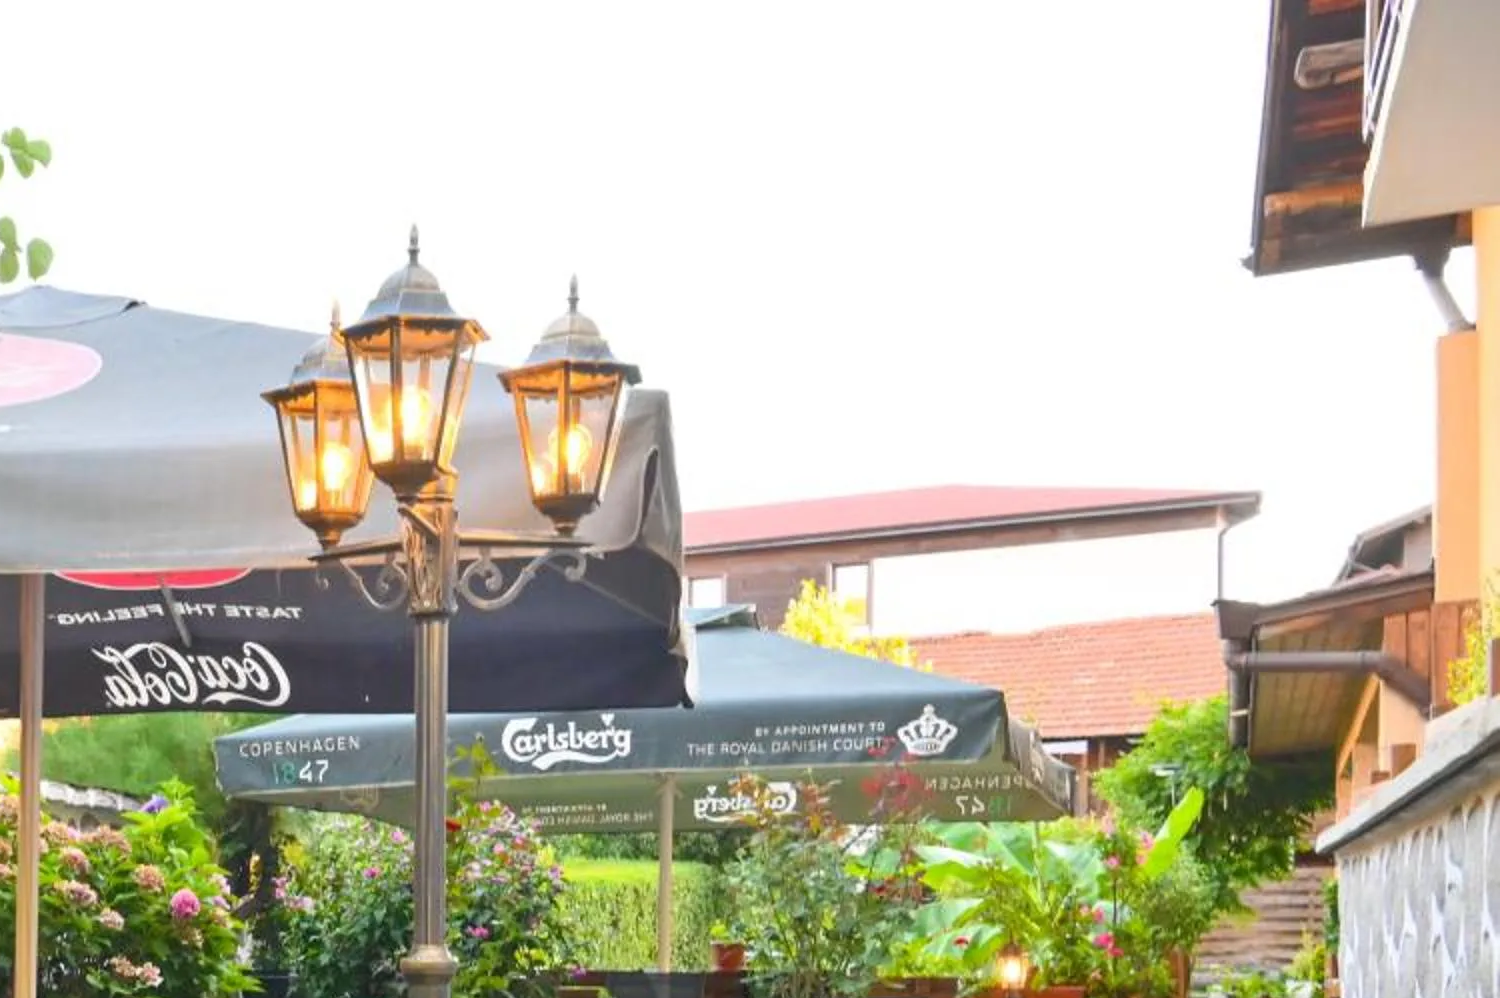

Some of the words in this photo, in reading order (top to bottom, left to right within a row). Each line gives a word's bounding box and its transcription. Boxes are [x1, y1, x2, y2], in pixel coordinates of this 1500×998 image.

[775, 722, 865, 737] APPOINTMENT
[239, 735, 361, 758] COPENHAGEN
[501, 713, 632, 771] Carlsberg
[687, 742, 715, 757] THE
[720, 739, 767, 756] ROYAL
[770, 738, 828, 754] DANISH
[272, 759, 330, 785] 1847
